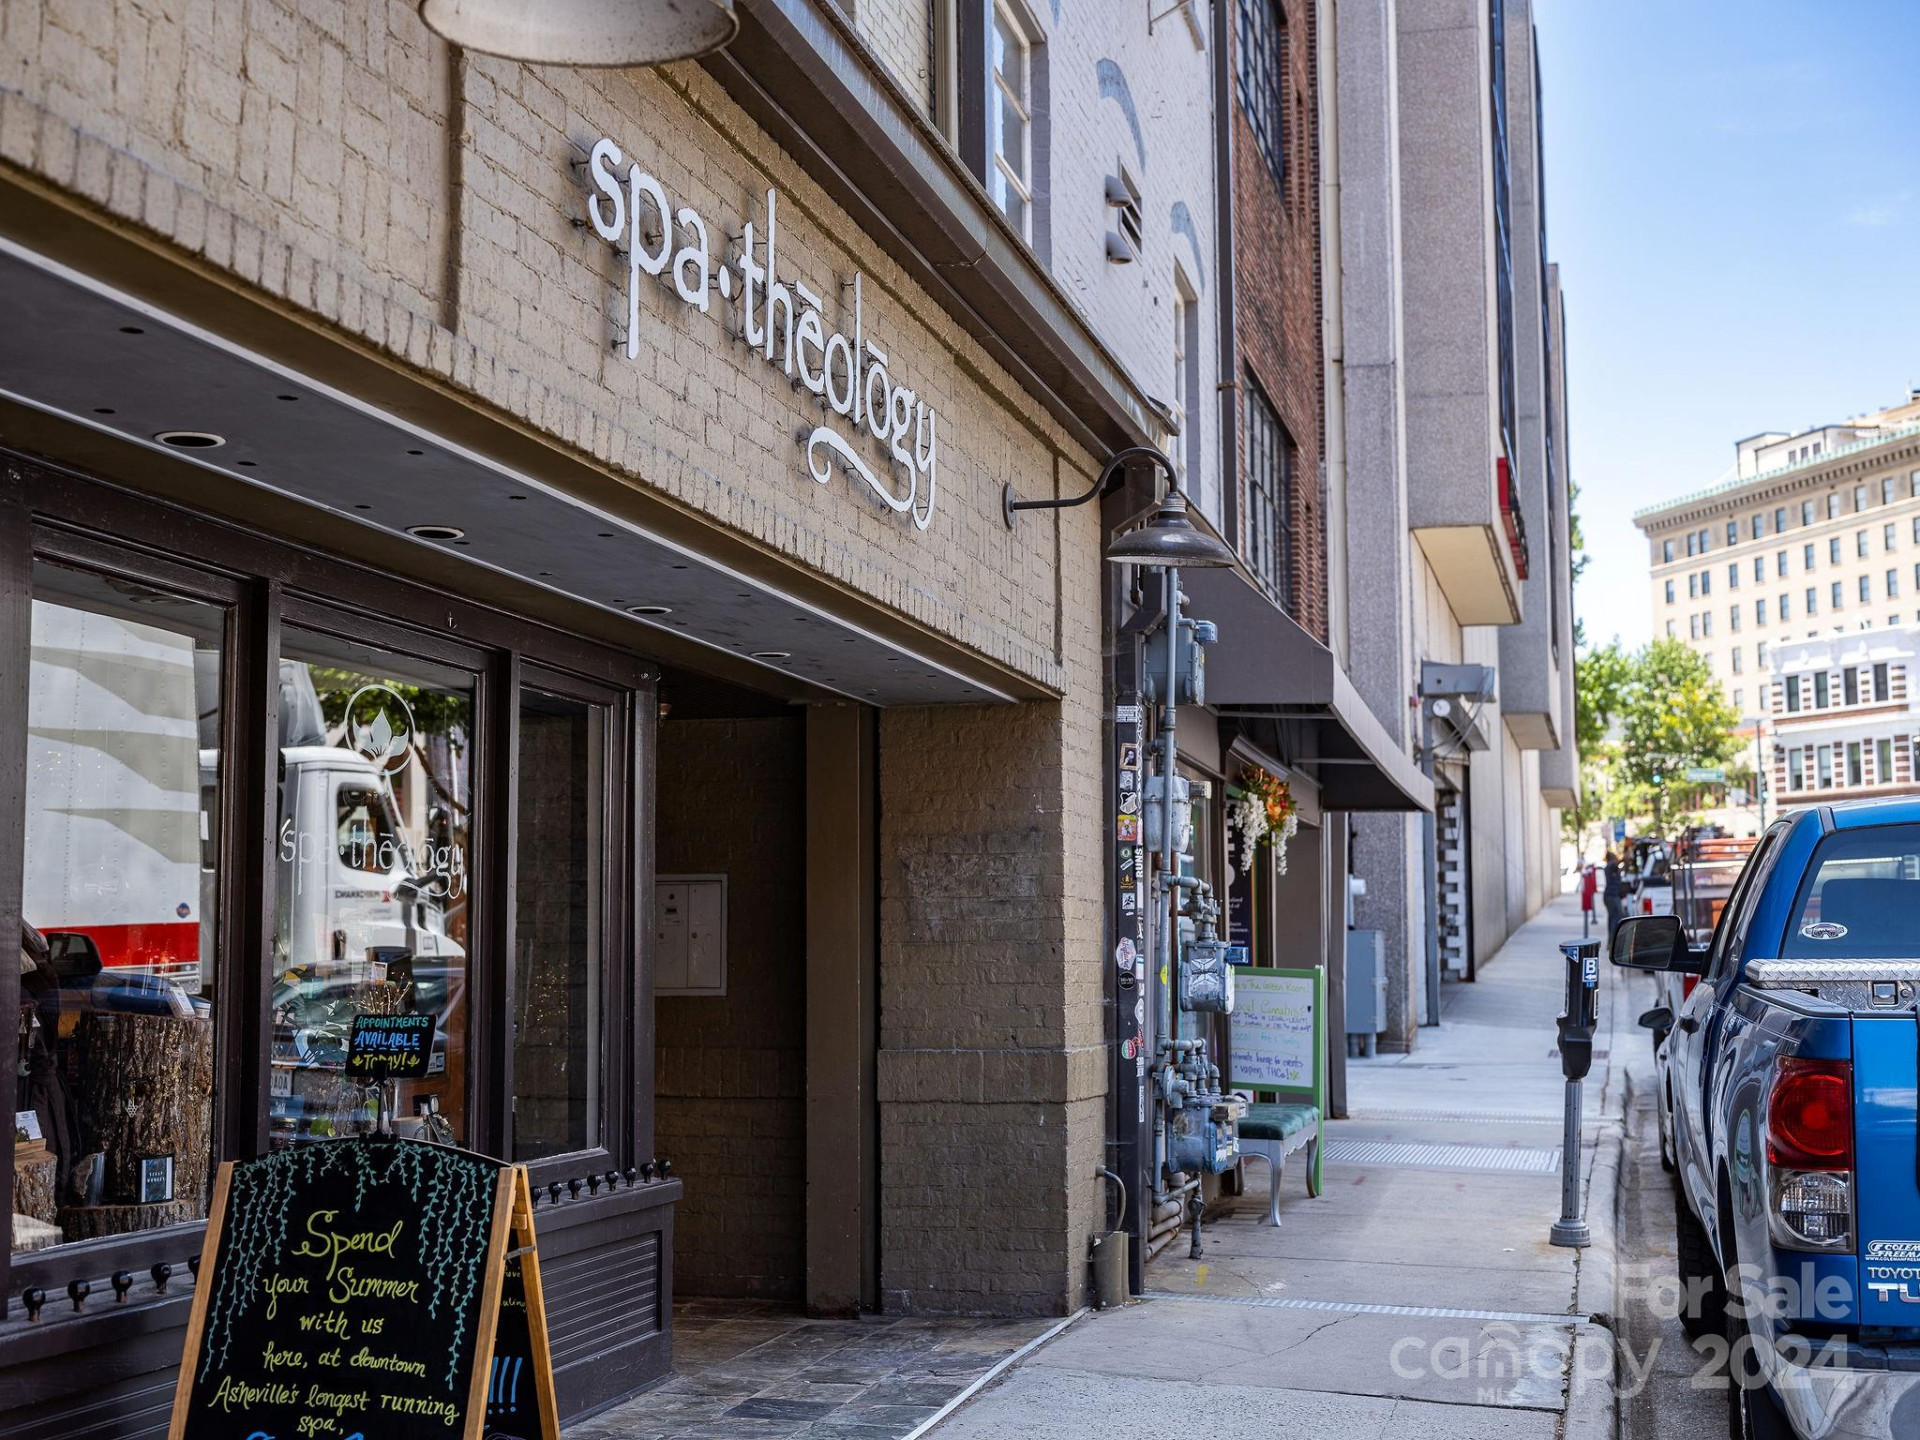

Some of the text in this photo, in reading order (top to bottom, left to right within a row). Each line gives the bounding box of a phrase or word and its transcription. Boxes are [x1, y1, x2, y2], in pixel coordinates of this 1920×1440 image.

[1585, 960, 1596, 974] B
[355, 1015, 429, 1029] APPOINTMENTS
[291, 1210, 403, 1281] Spend
[262, 1266, 419, 1320] your Summer
[299, 1309, 385, 1340] with us
[262, 1340, 426, 1377] here, at downtown
[208, 1375, 460, 1426] Asheville's longest running
[296, 1416, 344, 1438] spa,
